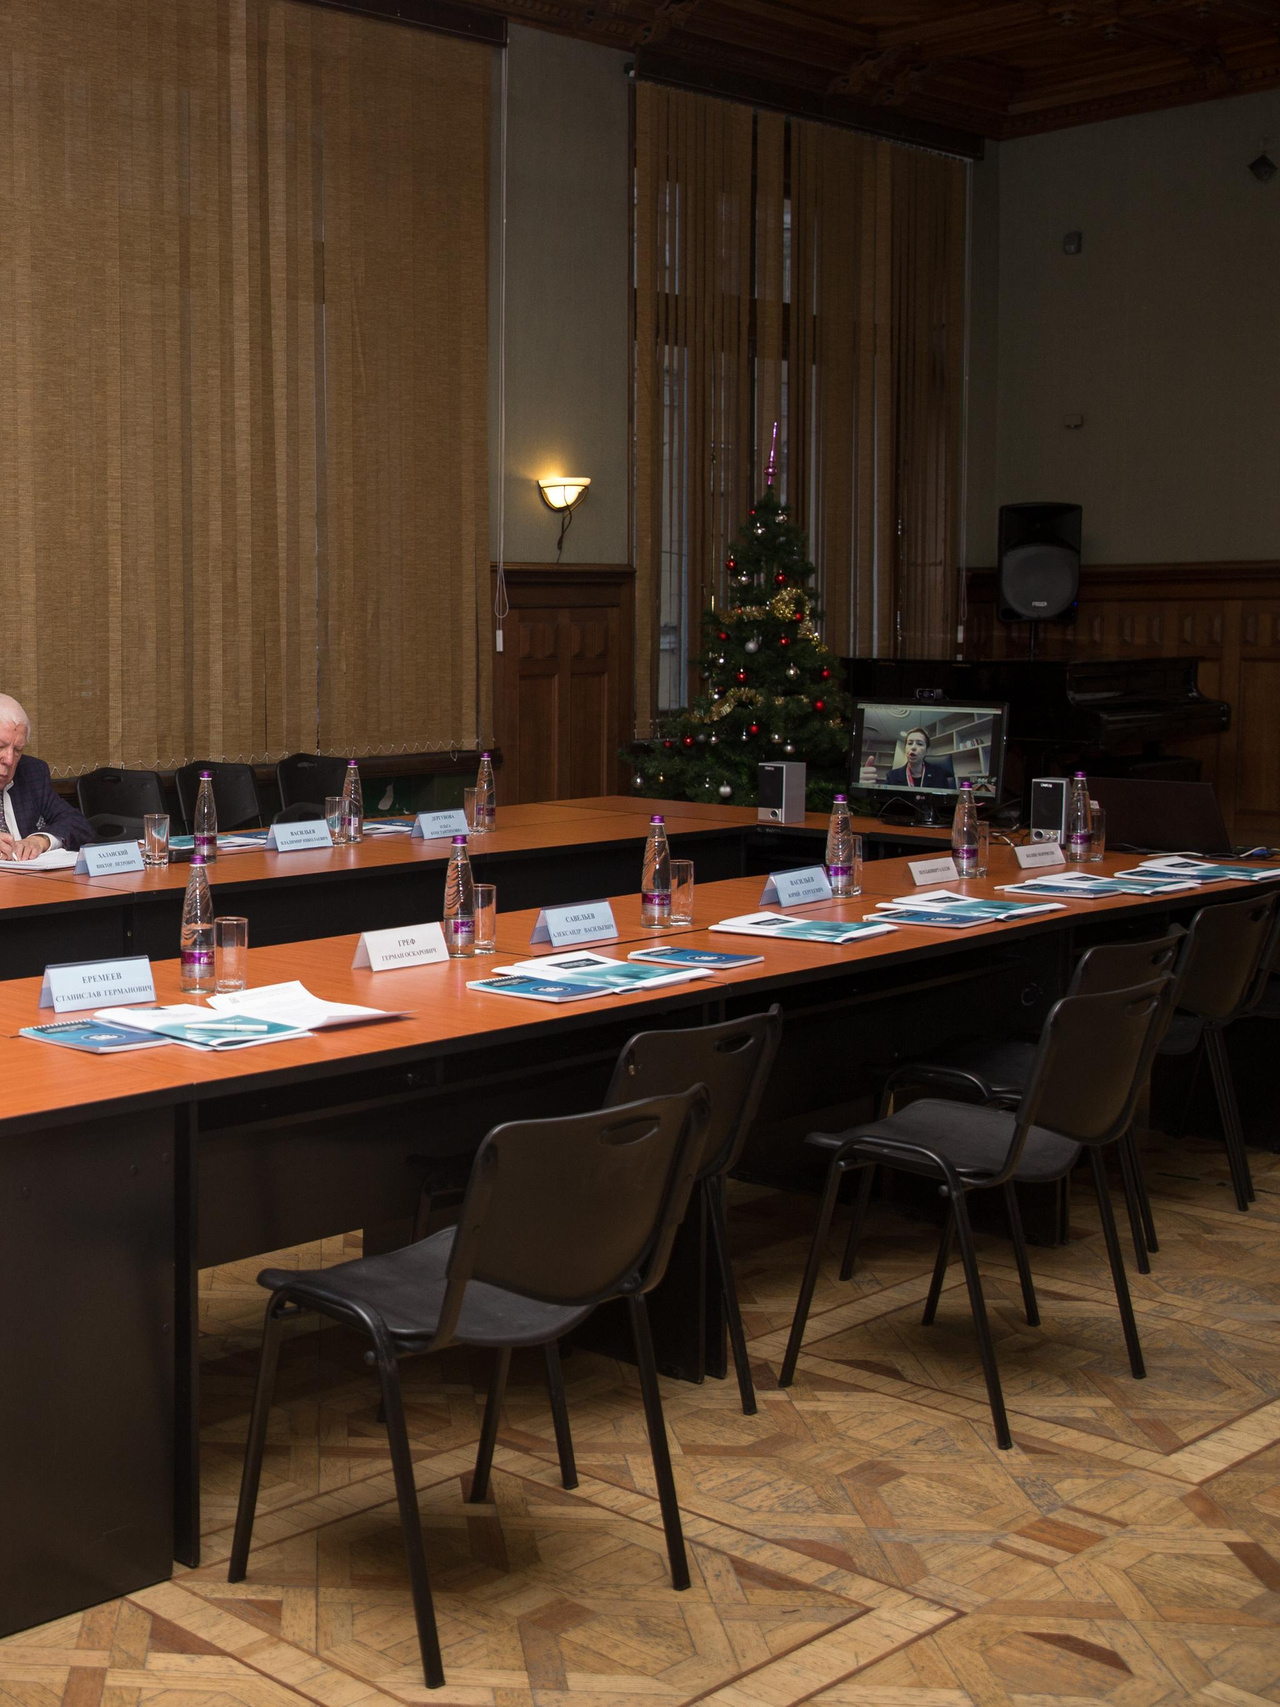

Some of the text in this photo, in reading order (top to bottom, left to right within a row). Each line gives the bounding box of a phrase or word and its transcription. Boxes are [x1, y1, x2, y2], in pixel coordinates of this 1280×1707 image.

[789, 876, 815, 886] ВАСИЛЬЕВ
[565, 913, 595, 923] САВЕЛЬЕВ
[553, 923, 615, 938] АЛЕКСАНДР ВАСИЛЬЕВИЧ
[397, 938, 416, 947] ГРЕФ
[381, 947, 437, 961] ГЕРМАН ОСКАРОВИЧ
[82, 972, 122, 984] ЕРЕМЕЕВ
[55, 984, 152, 1002] СТАНИСЛАВ ГЕРМАНОВИЧ
